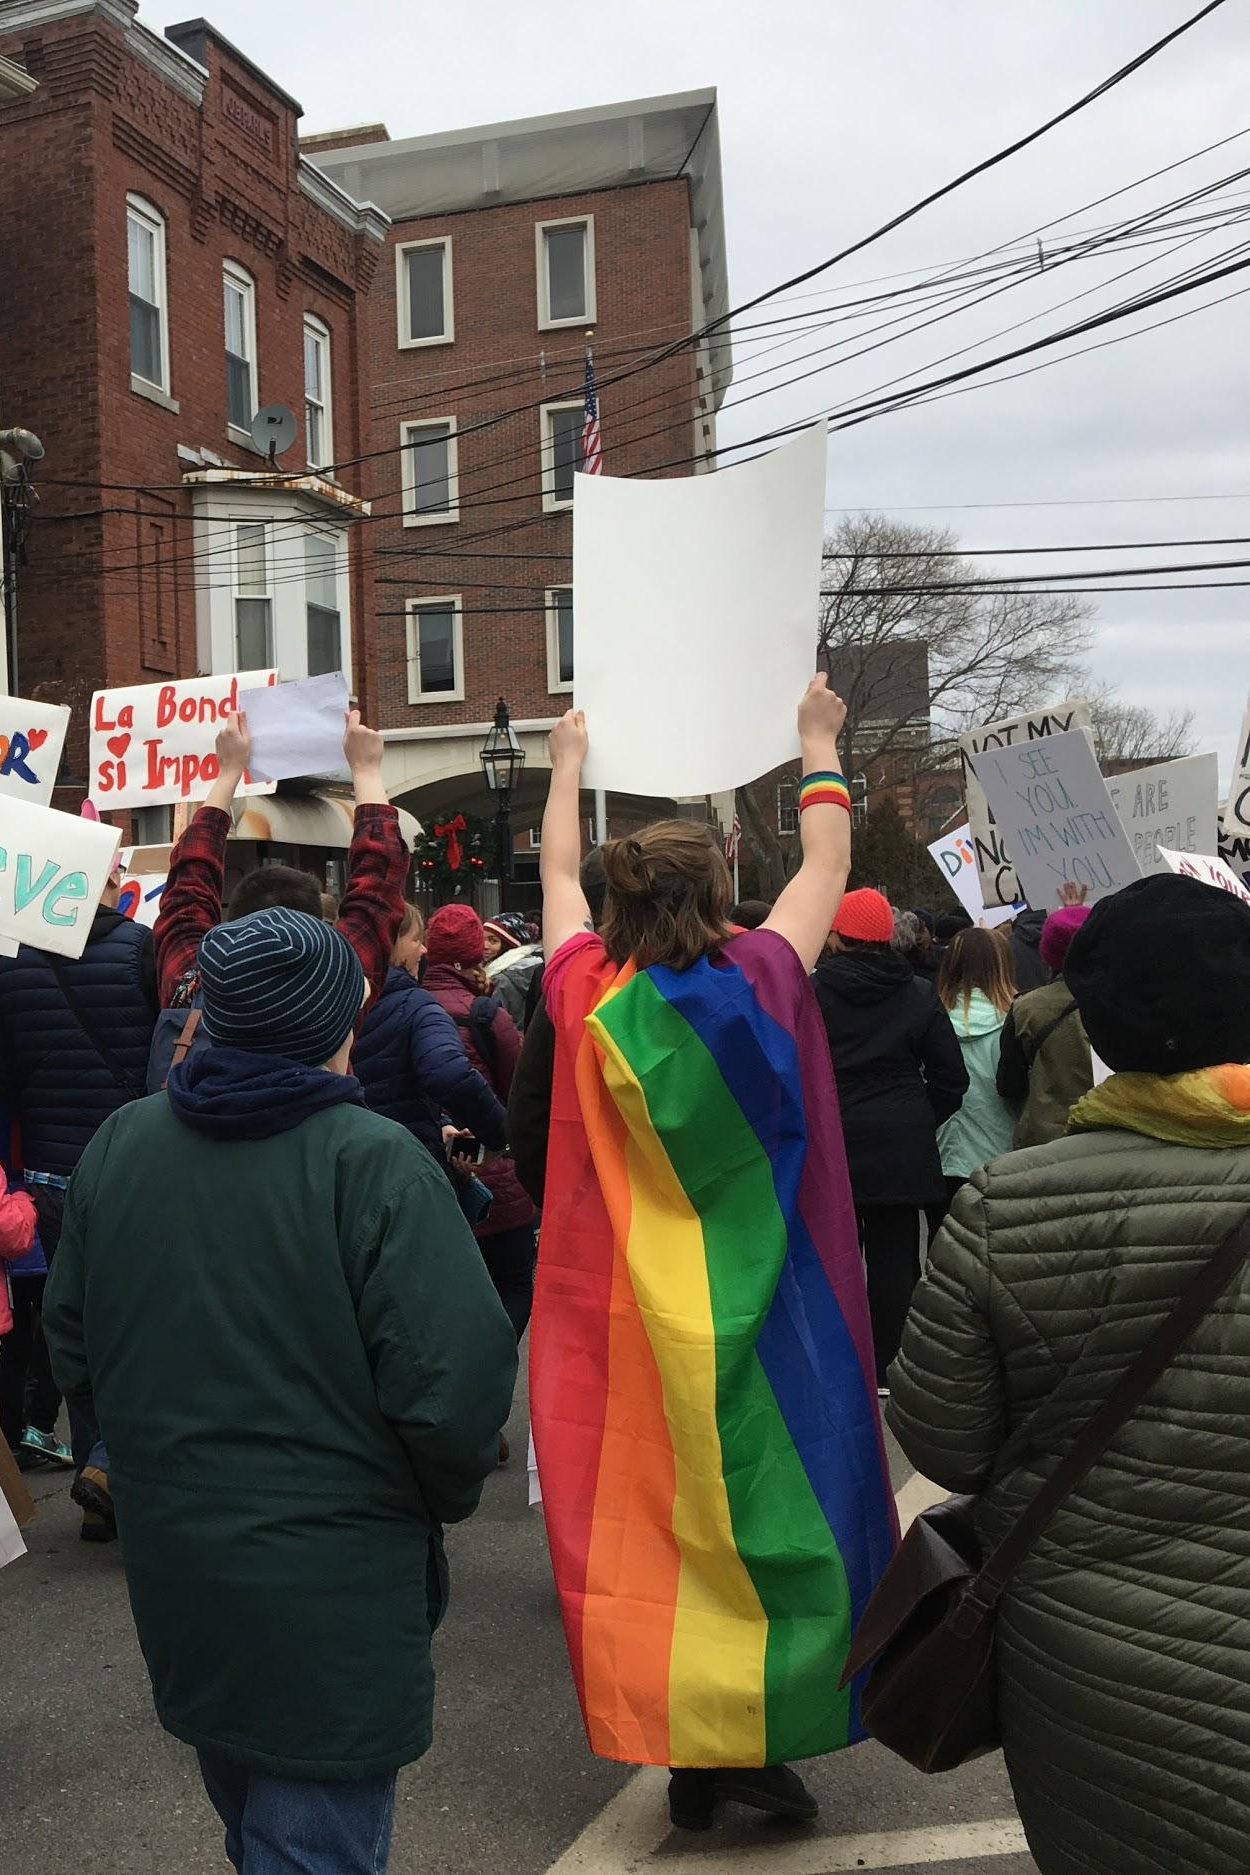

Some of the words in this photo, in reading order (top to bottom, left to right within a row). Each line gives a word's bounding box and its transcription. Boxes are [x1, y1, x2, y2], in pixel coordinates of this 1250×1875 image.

[94, 696, 134, 731] La
[993, 759, 1008, 785] I
[1018, 747, 1059, 780] SEE
[1016, 778, 1079, 817] YOU.
[1132, 779, 1170, 818] ARE
[1050, 811, 1116, 848] WITH
